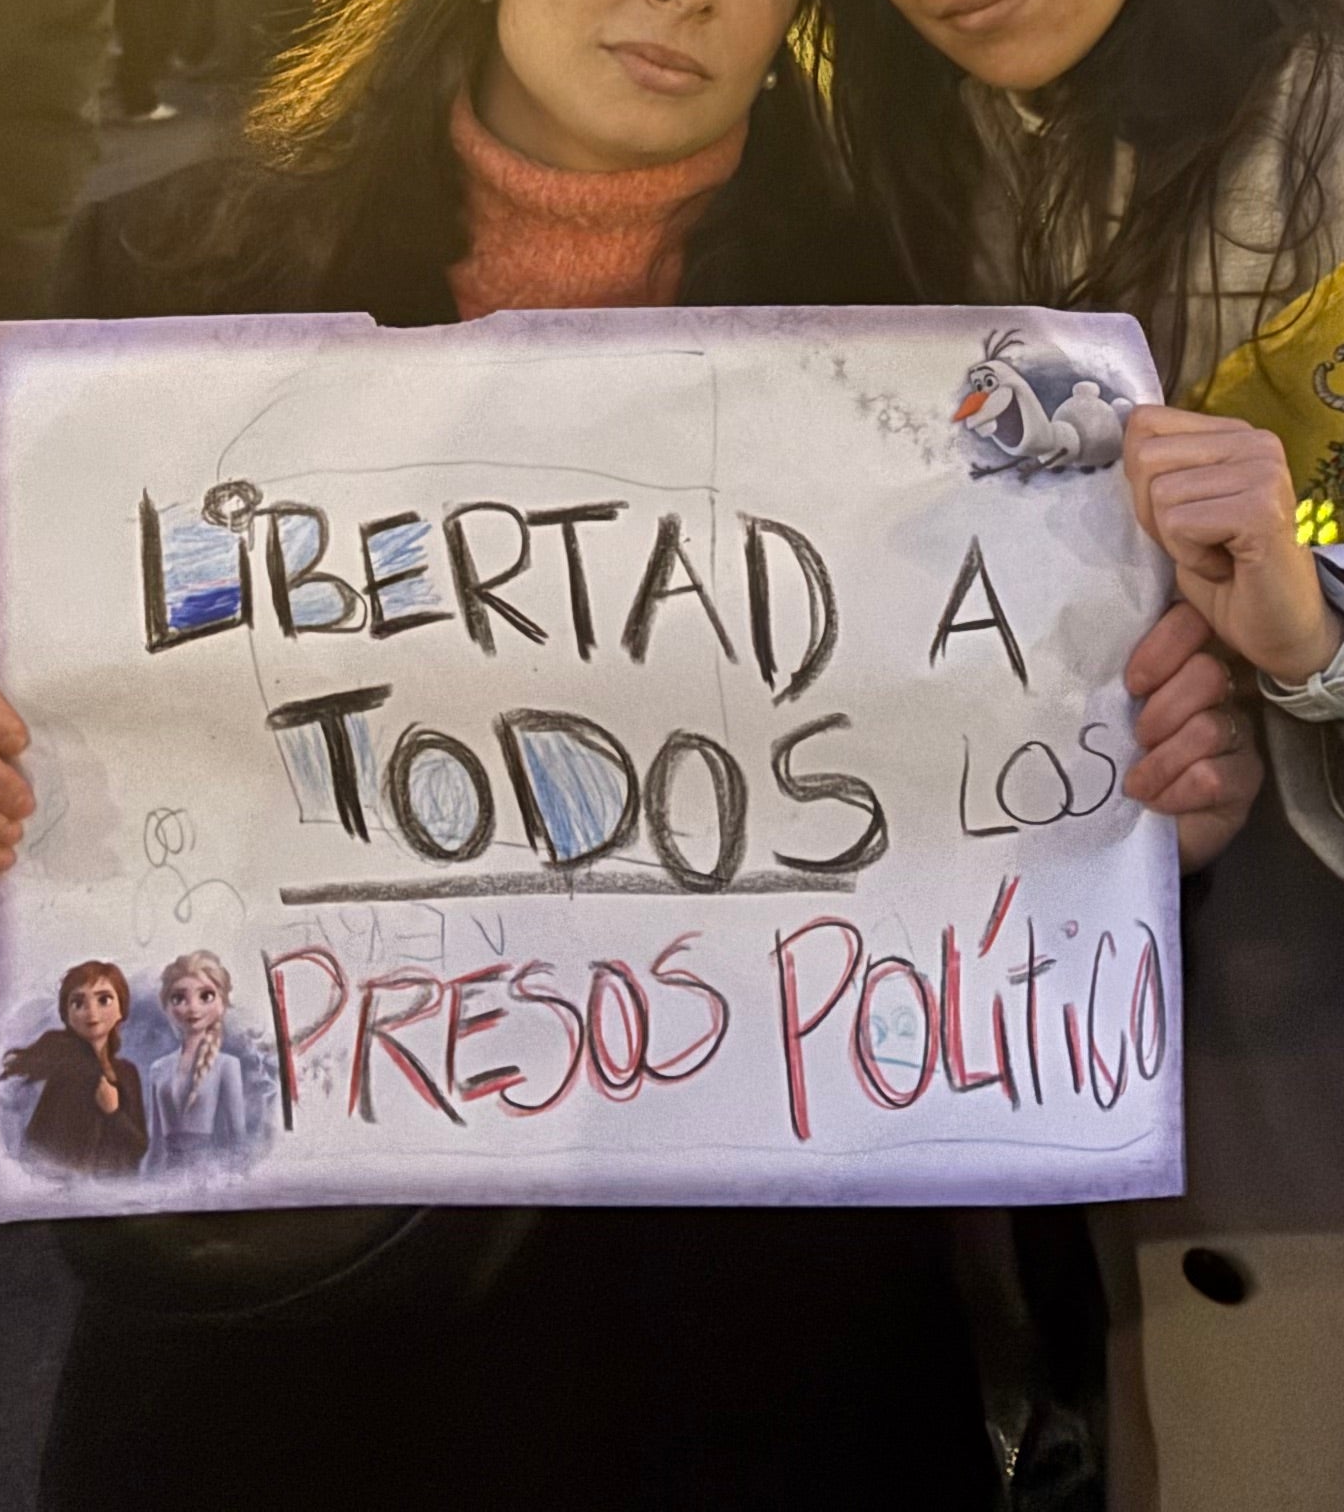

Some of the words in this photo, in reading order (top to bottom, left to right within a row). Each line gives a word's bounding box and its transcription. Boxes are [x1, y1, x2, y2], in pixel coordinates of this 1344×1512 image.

[929, 534, 1028, 692] A
[265, 684, 889, 892] TODOS
[959, 722, 1116, 836] LOS
[261, 931, 729, 1130] PRESOS
